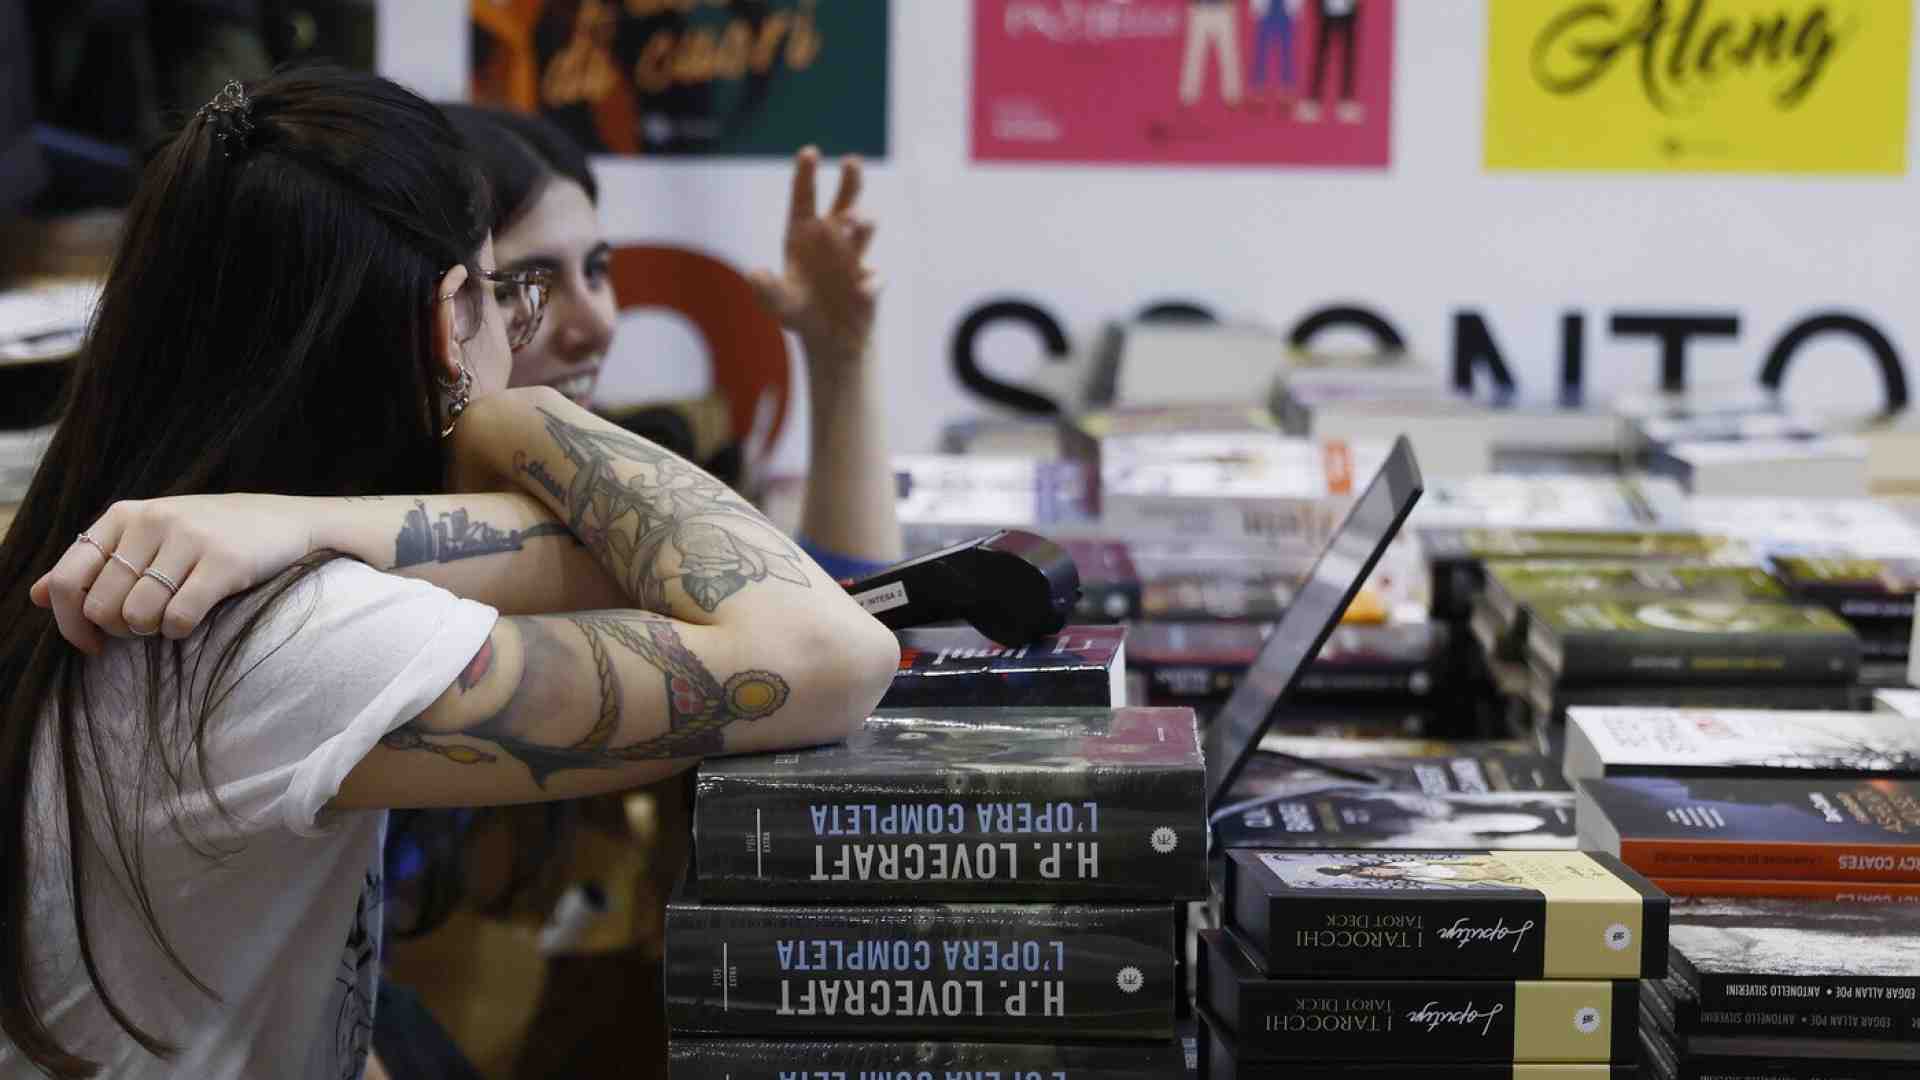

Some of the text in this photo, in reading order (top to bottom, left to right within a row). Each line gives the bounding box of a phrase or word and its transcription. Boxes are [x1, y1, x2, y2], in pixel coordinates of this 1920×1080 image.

[810, 802, 1100, 835] L'OPERA COMPLETA
[809, 842, 1100, 880] H.P. LOVECRAFT
[1838, 855, 1891, 871] COATES
[1296, 930, 1415, 948] TAROCCHI
[775, 941, 1065, 971] L'OPERA COMPLETA
[774, 979, 1065, 1015] H.P. LOVECRAFT
[1726, 984, 1916, 999] EDGAR ALLAN POE ANTONELLO SILVERINI
[1265, 1015, 1382, 1031] TAROCCHI
